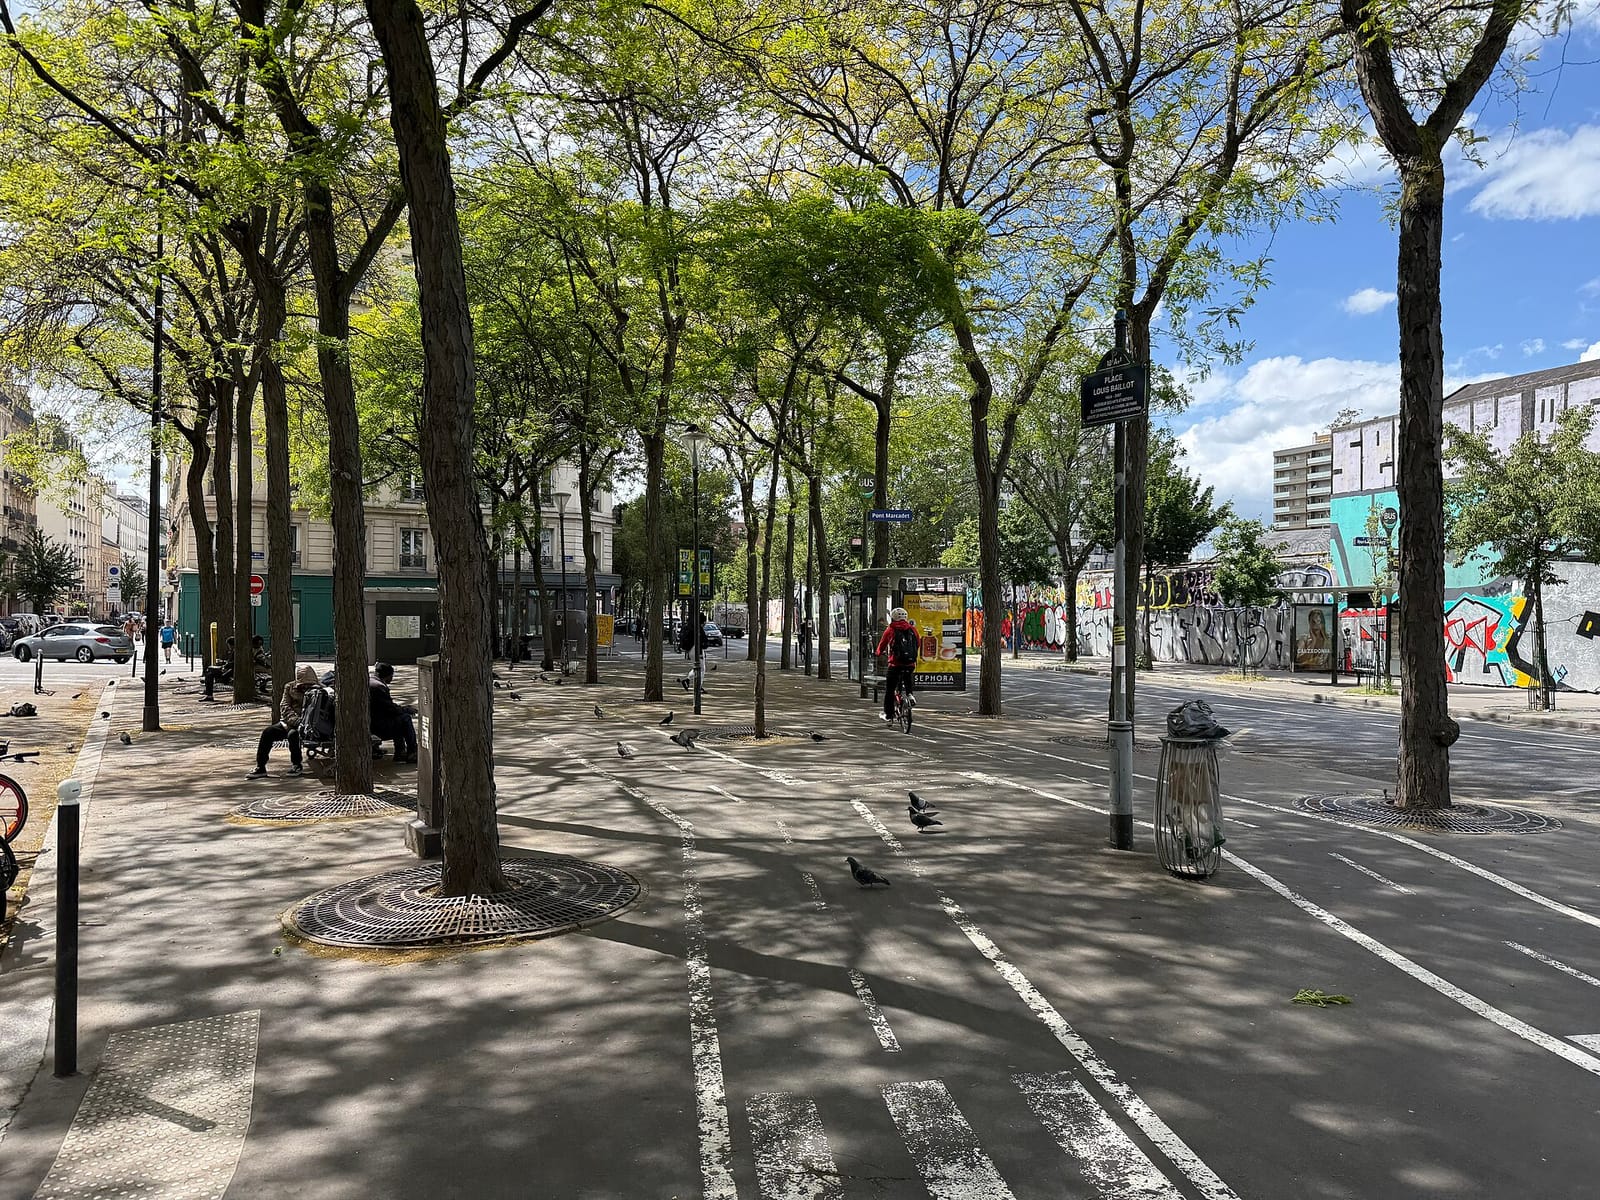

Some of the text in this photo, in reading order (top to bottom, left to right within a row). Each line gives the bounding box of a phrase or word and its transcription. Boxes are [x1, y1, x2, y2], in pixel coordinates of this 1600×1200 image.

[1104, 374, 1123, 384] PLACE
[1093, 386, 1109, 396] LOUIS
[1110, 381, 1135, 392] BAILLOT
[859, 478, 874, 487] BUS
[914, 674, 954, 682] SEPHORA
